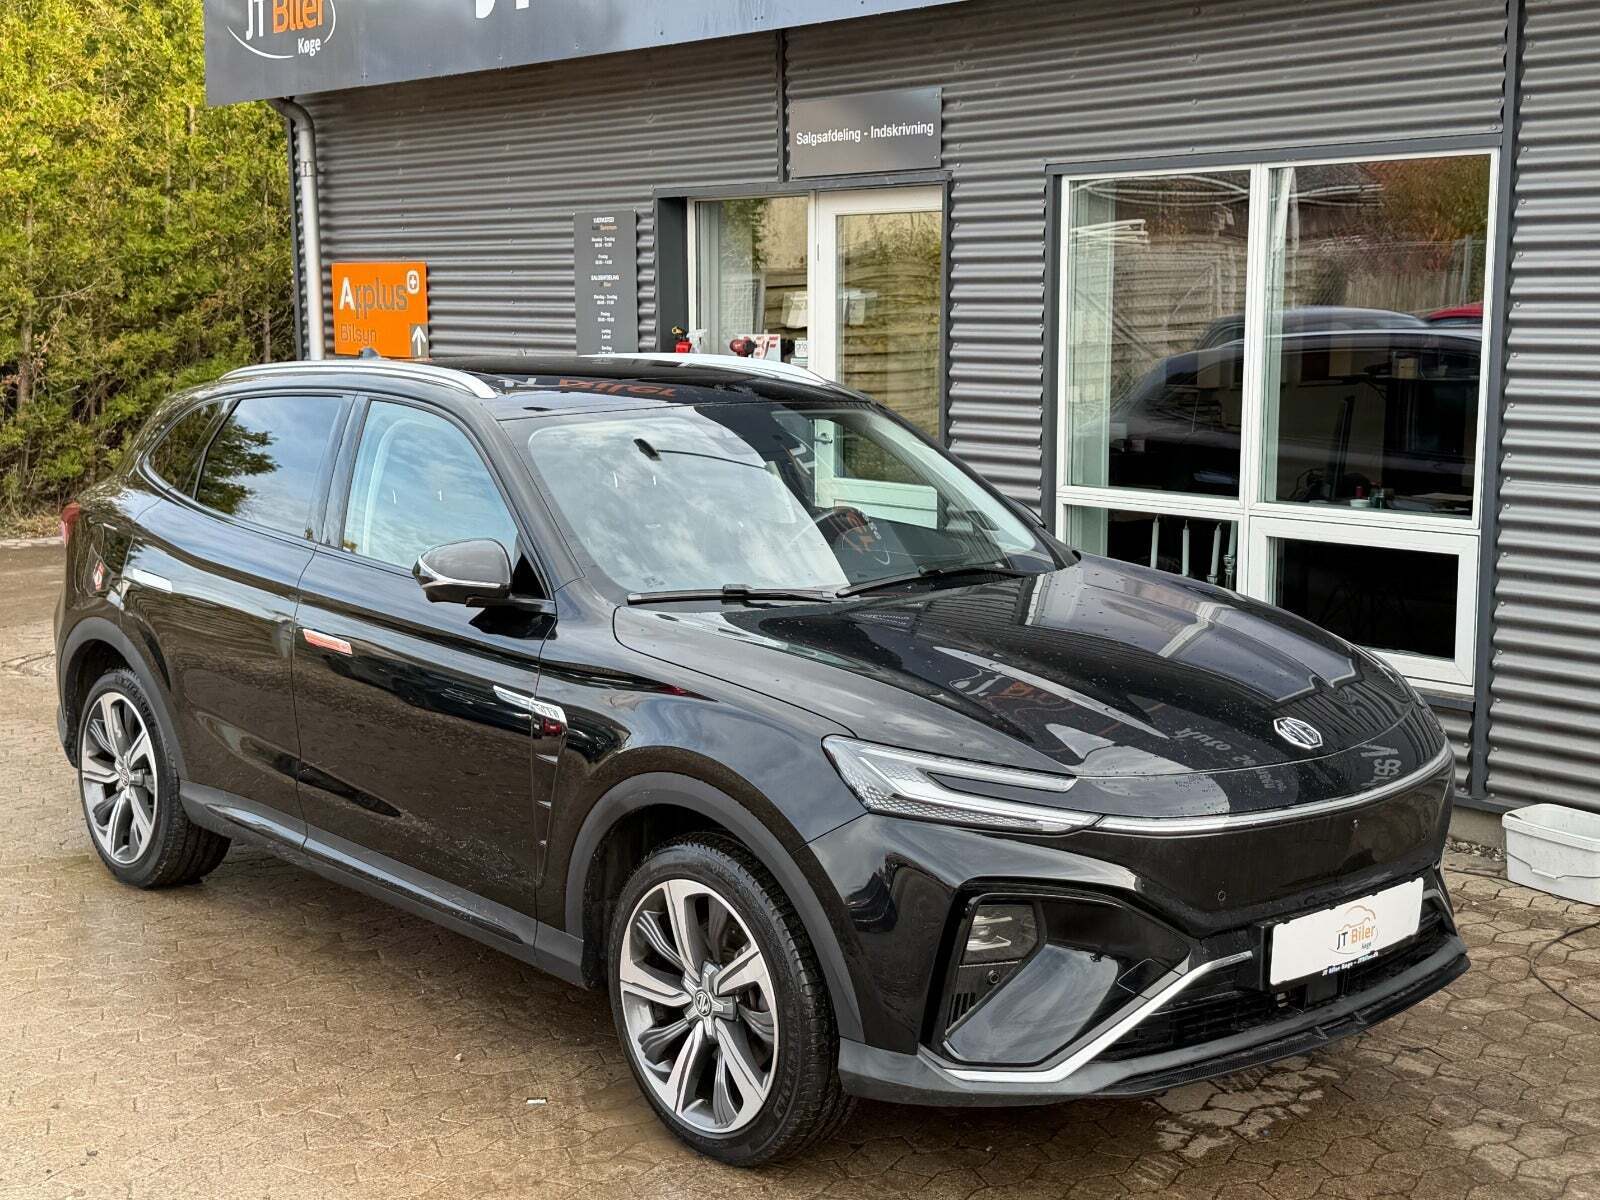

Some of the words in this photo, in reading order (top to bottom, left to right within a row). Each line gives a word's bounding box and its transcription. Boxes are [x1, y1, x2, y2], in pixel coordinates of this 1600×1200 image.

[245, 0, 264, 40] JT
[297, 37, 321, 56] Køge
[796, 127, 861, 146] Salgsafdeling
[870, 121, 934, 138] Indskrivning
[340, 323, 377, 345] Bilsyn
[1336, 931, 1348, 950] JT
[1351, 925, 1375, 944] Biler
